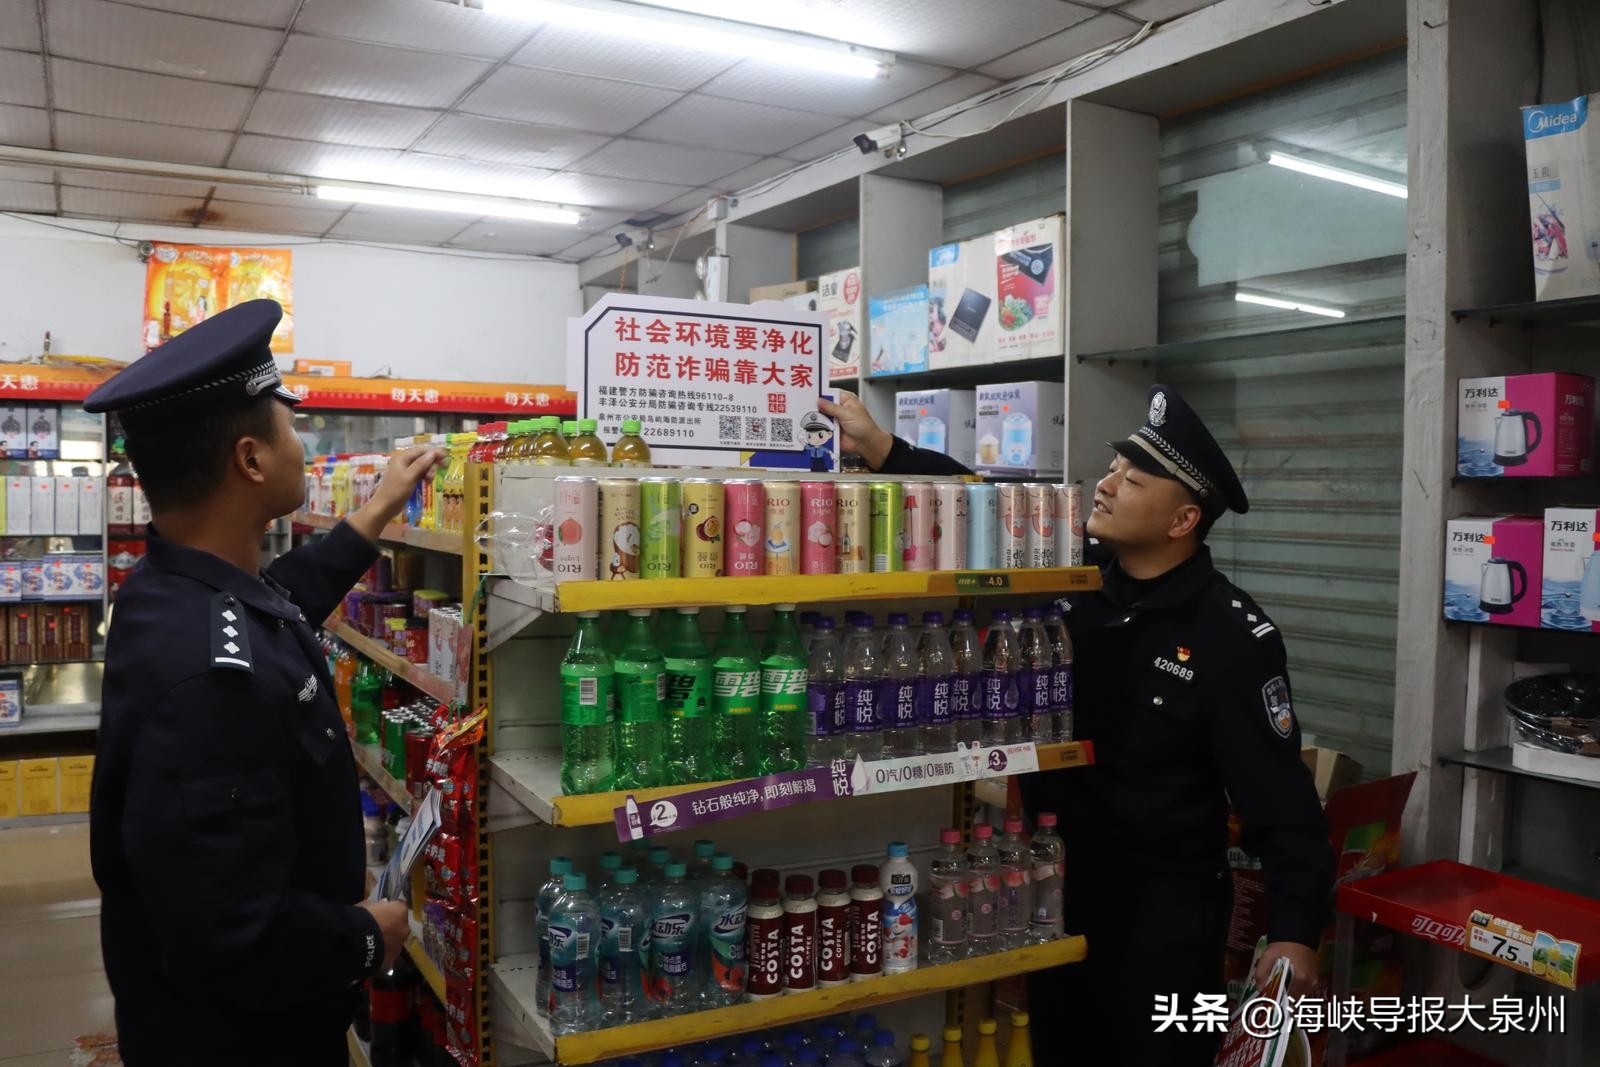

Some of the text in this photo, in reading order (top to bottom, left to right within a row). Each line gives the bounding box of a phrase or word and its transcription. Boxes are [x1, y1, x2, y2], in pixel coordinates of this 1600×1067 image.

[1537, 111, 1577, 130] Midea
[615, 316, 813, 356] 社会环境要净化
[615, 353, 813, 388] 防范诈骗靠大家
[391, 387, 439, 404] 每天惠
[504, 391, 550, 407] 每天惠
[598, 385, 734, 402] 福建警方防骗咨询热线96110-8
[1464, 388, 1499, 398] 万利达
[598, 397, 758, 414] 丰泽公安分局防骗咨询专线22539110
[643, 427, 695, 438] 22689110
[768, 498, 791, 507] RIO
[811, 499, 834, 507] RIO
[837, 499, 858, 507] RIO
[1452, 532, 1486, 543] 万利达
[1551, 521, 1588, 532] 万利达
[558, 564, 583, 573] RIO
[647, 562, 672, 571] RIO
[700, 562, 716, 570] RIO
[735, 561, 759, 570] RIO
[1153, 656, 1194, 681] 420689
[714, 671, 760, 697] 雪碧
[760, 668, 808, 695] 雪碧
[1035, 674, 1049, 706] 纯悦
[1052, 672, 1067, 703] 纯悦
[898, 685, 913, 719] 纯悦
[934, 682, 949, 716] 纯悦
[953, 679, 969, 712] 纯悦
[986, 677, 1001, 711] 纯悦
[857, 689, 874, 723] 纯悦
[992, 751, 1001, 766] 3
[831, 758, 850, 796] 纯悦
[876, 762, 955, 782] 0汽/0糖/0脂肪
[656, 804, 669, 821] 2
[821, 917, 834, 971] COSTA
[866, 912, 880, 964] COSTA
[1491, 935, 1519, 962] 7.5
[365, 934, 375, 968] POLICE
[766, 927, 779, 984] COSTA
[790, 923, 804, 979] COSTA
